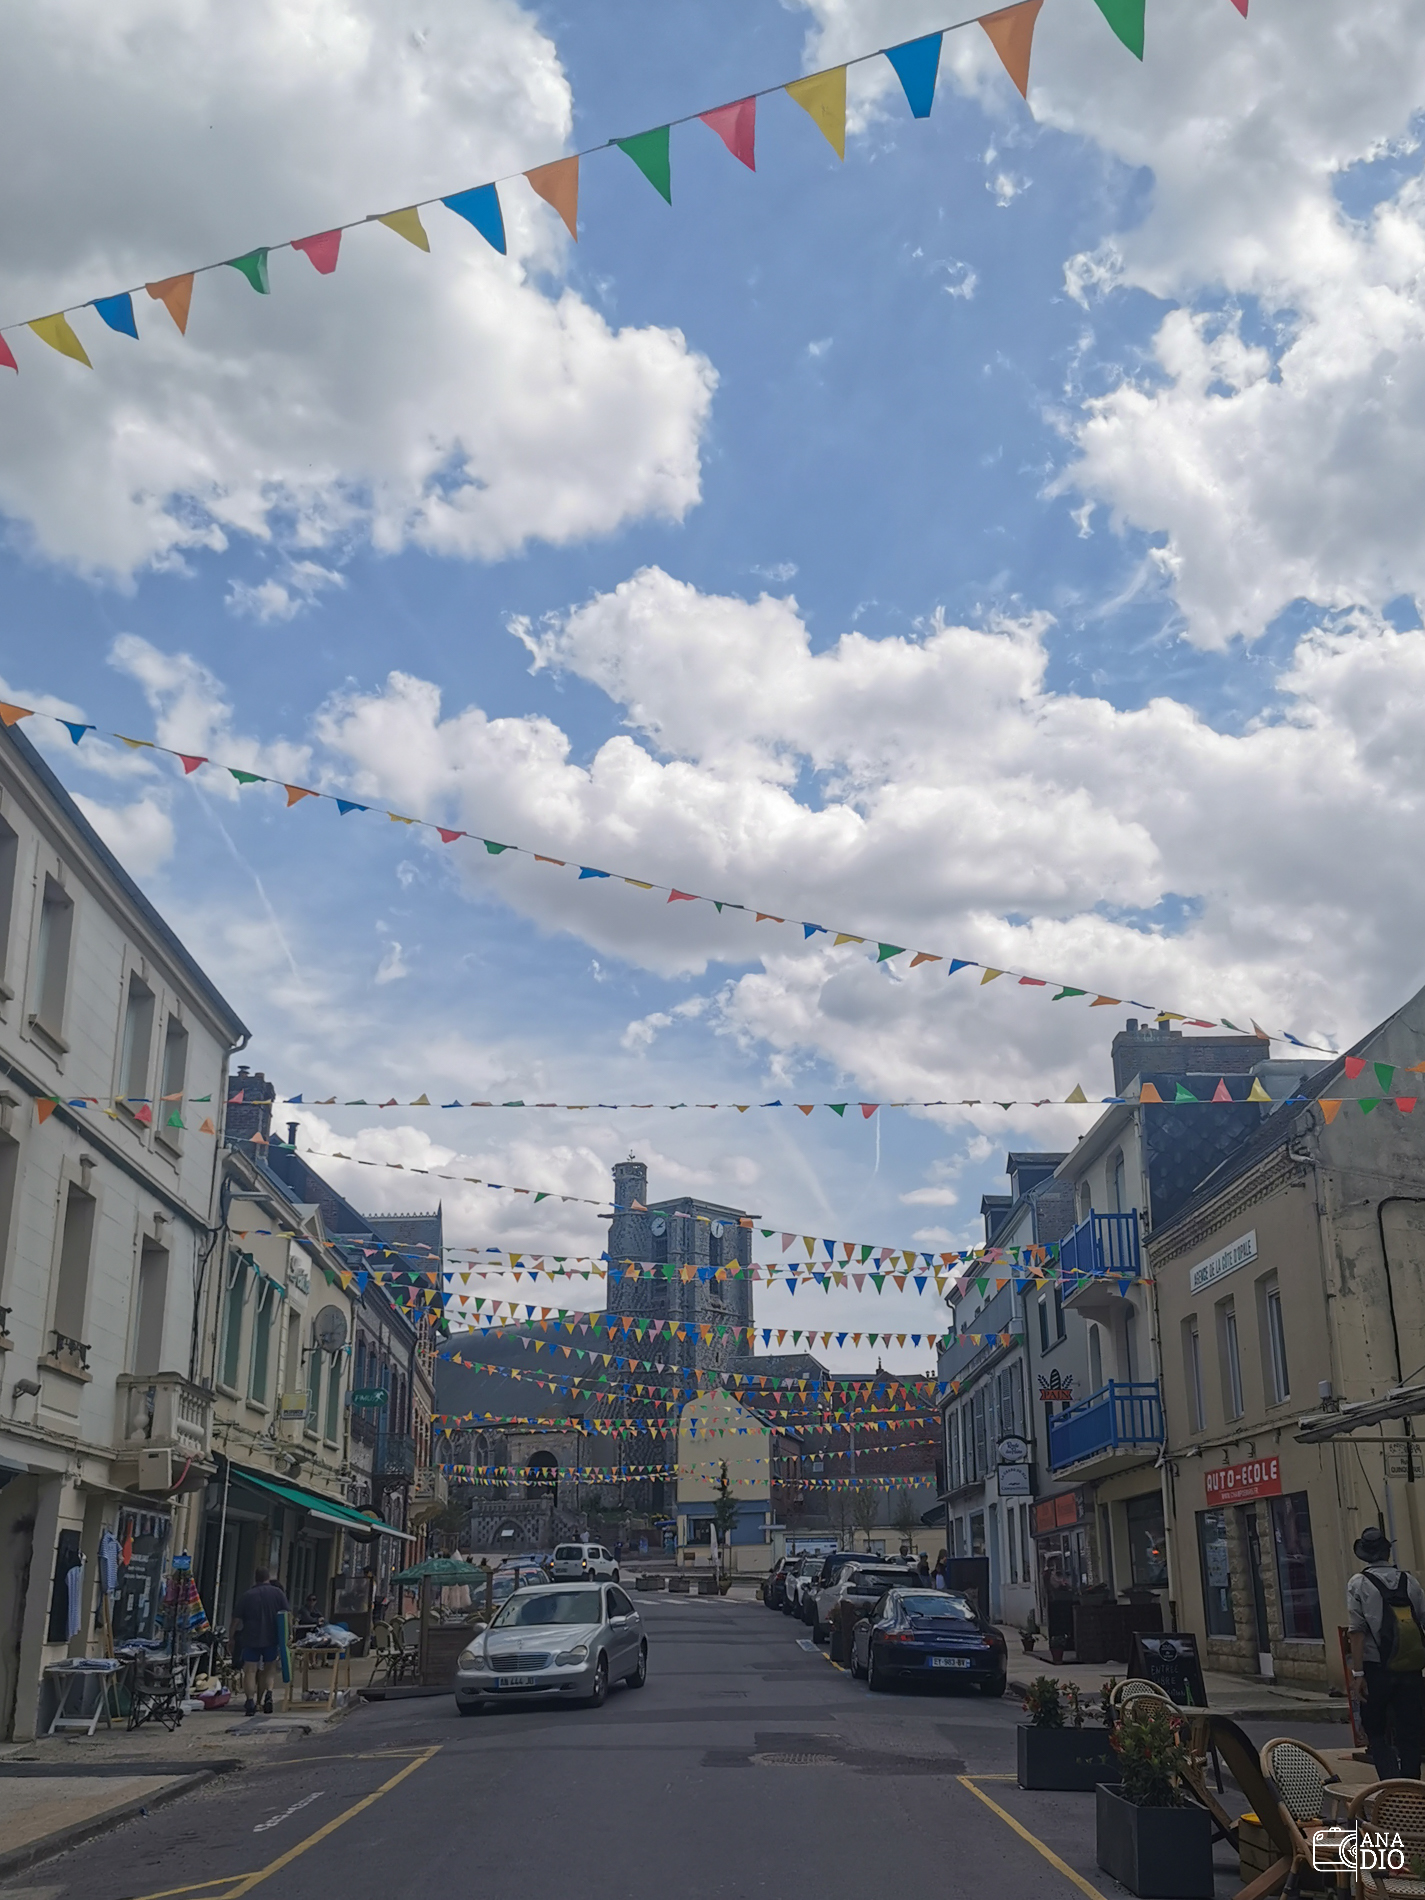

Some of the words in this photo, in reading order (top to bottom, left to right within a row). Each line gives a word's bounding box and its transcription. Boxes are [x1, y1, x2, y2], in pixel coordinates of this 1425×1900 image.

[1194, 1266, 1208, 1286] AGENCE
[1209, 1262, 1215, 1277] DE
[1215, 1259, 1221, 1273] LA
[1044, 1391, 1069, 1400] PAIN
[1207, 1460, 1277, 1492] AUTO-ECOLE
